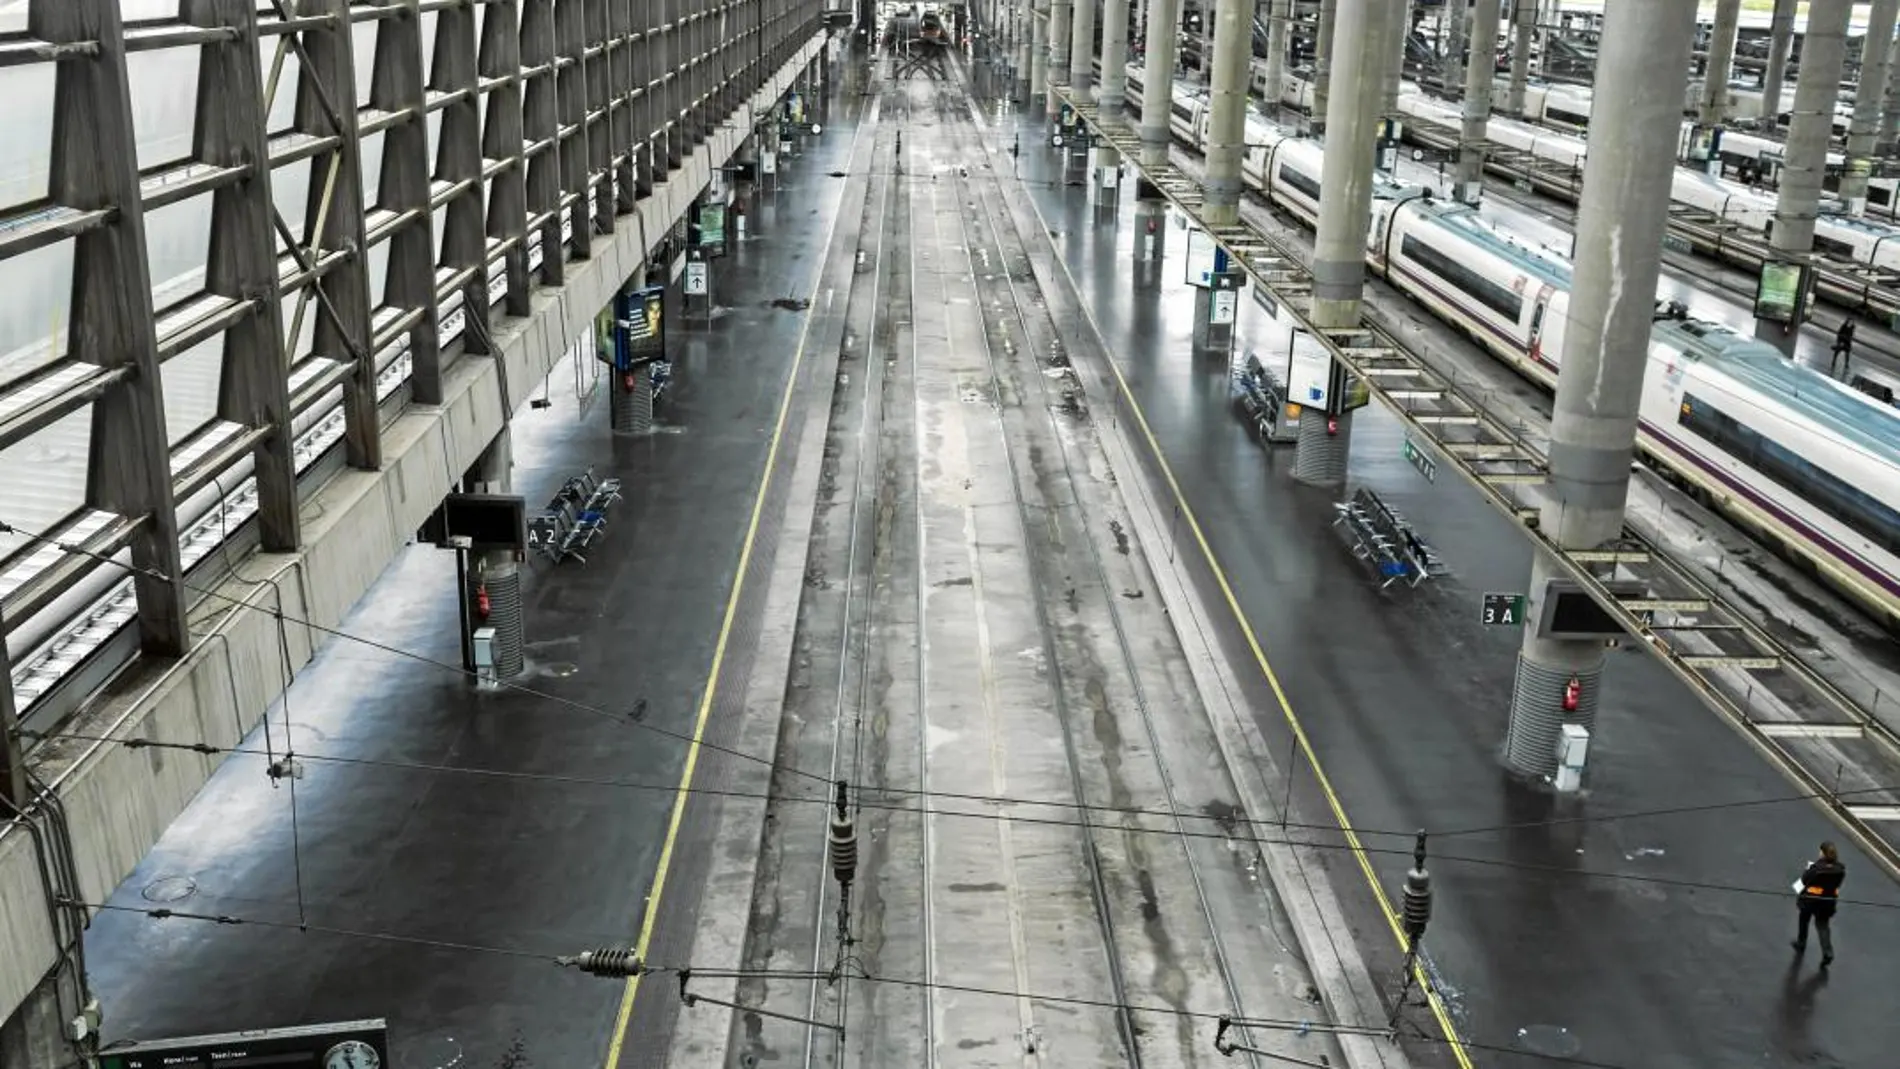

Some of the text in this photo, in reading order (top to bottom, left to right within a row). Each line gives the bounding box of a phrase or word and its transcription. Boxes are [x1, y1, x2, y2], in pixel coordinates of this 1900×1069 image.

[529, 529, 555, 543] A 2
[1484, 608, 1514, 623] 3 A
